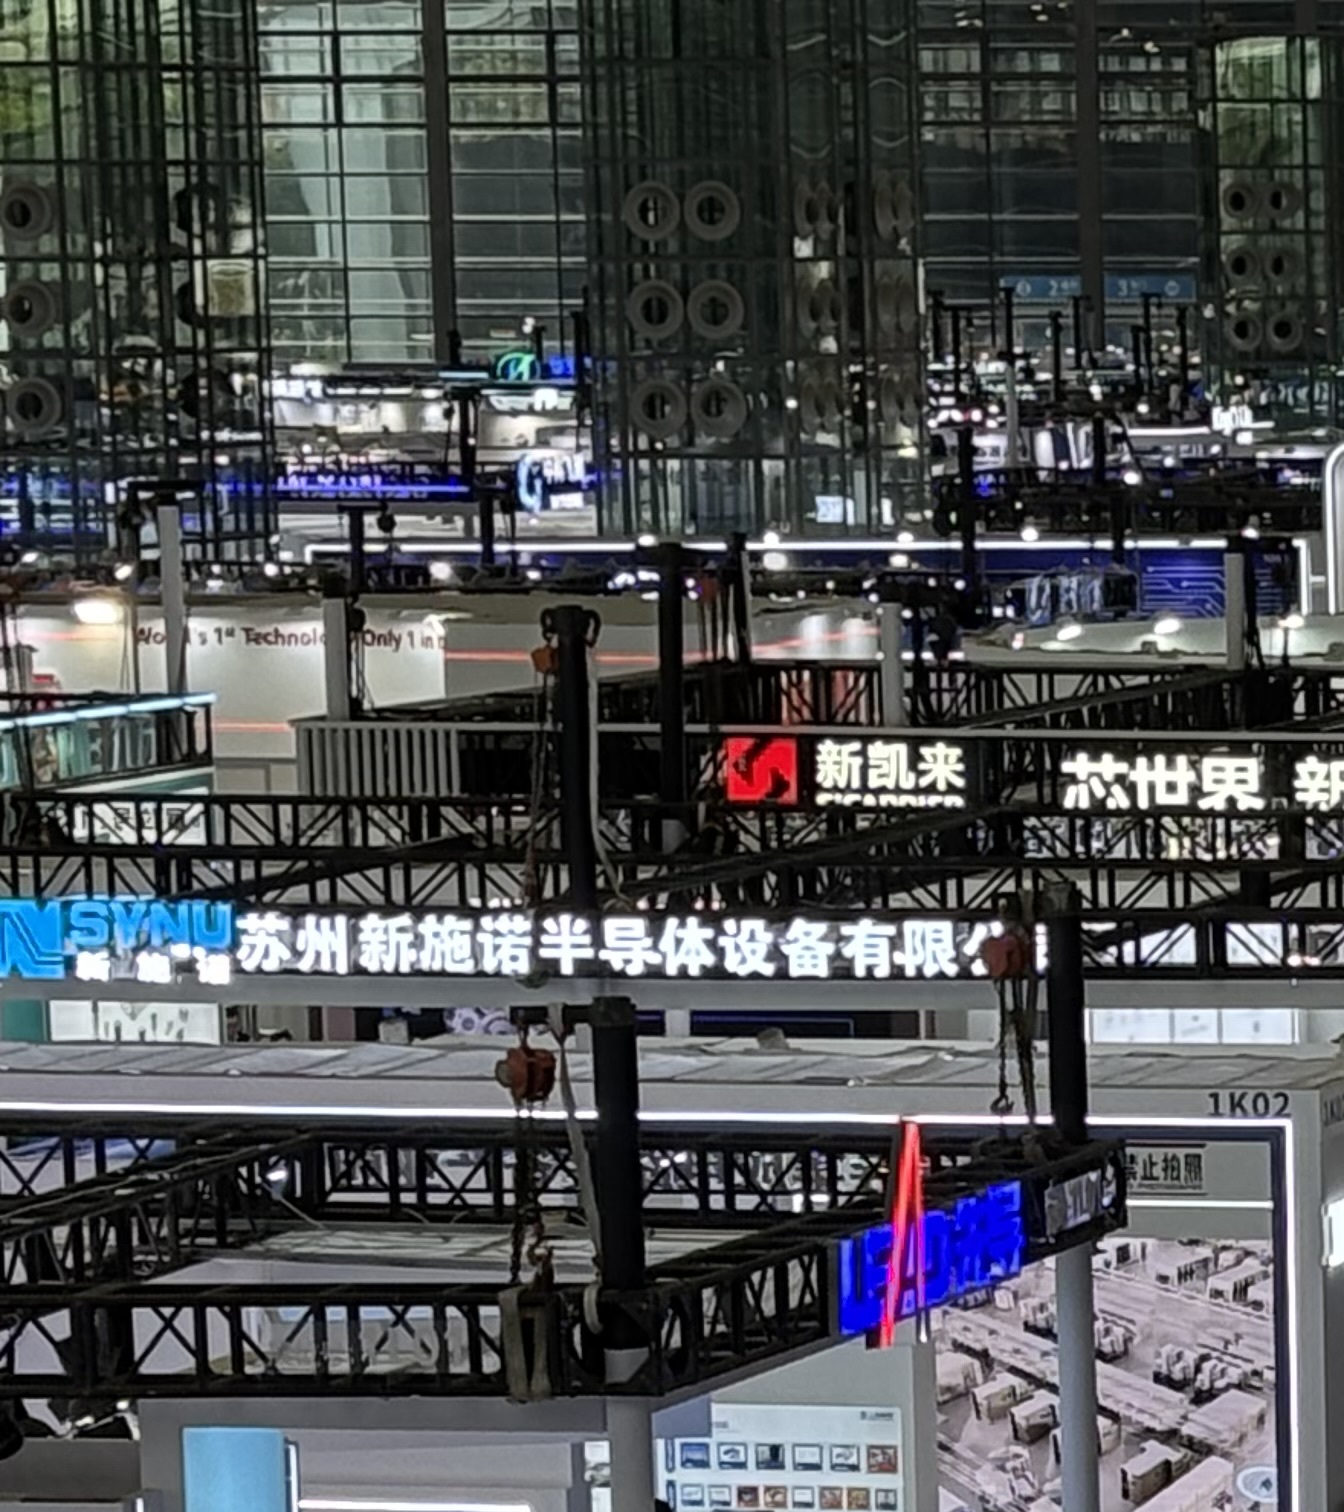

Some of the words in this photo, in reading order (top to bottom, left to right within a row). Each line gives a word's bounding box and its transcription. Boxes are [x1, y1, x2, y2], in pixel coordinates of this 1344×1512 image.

[814, 738, 967, 792] 新凯来
[1060, 753, 1266, 811] 芯世界
[236, 910, 1048, 978] 苏州新施诺半导体设备有限公
[1207, 1090, 1292, 1118] 1K02
